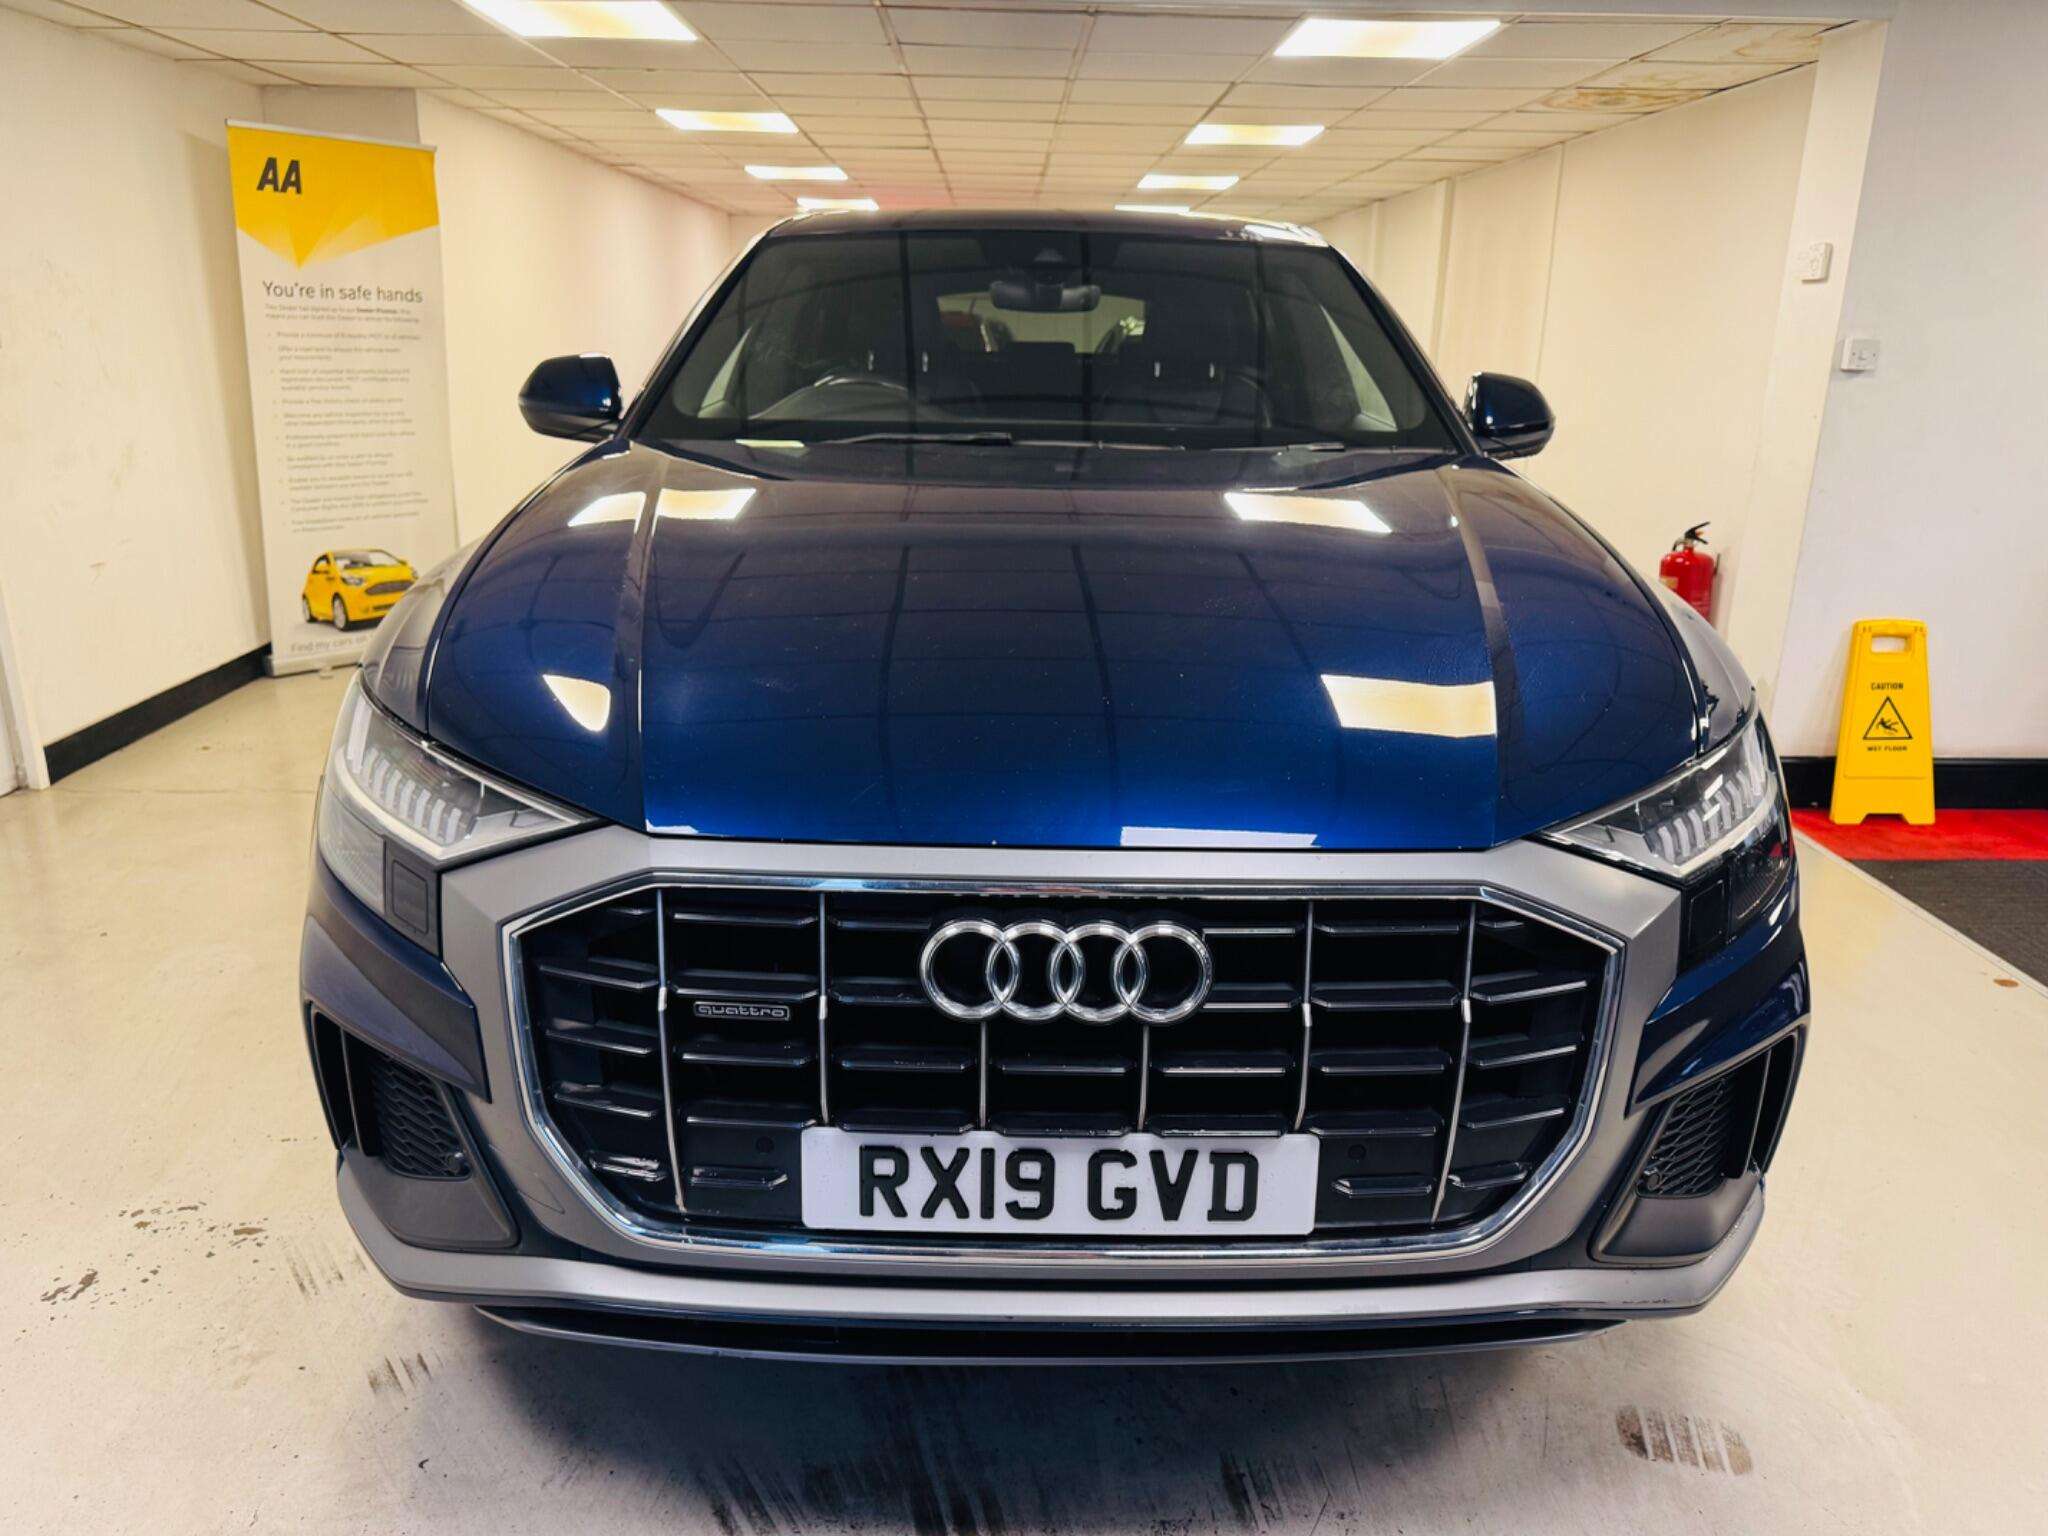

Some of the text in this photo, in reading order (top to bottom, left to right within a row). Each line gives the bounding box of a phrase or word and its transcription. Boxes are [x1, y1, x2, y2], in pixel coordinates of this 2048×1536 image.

[256, 156, 303, 195] AA
[262, 280, 424, 304] You're in safe hands
[1871, 682, 1904, 691] CAUTION
[1884, 744, 1908, 752] FLOOR
[698, 1004, 785, 1017] quattro
[858, 1144, 1261, 1223] RX19 GVD
